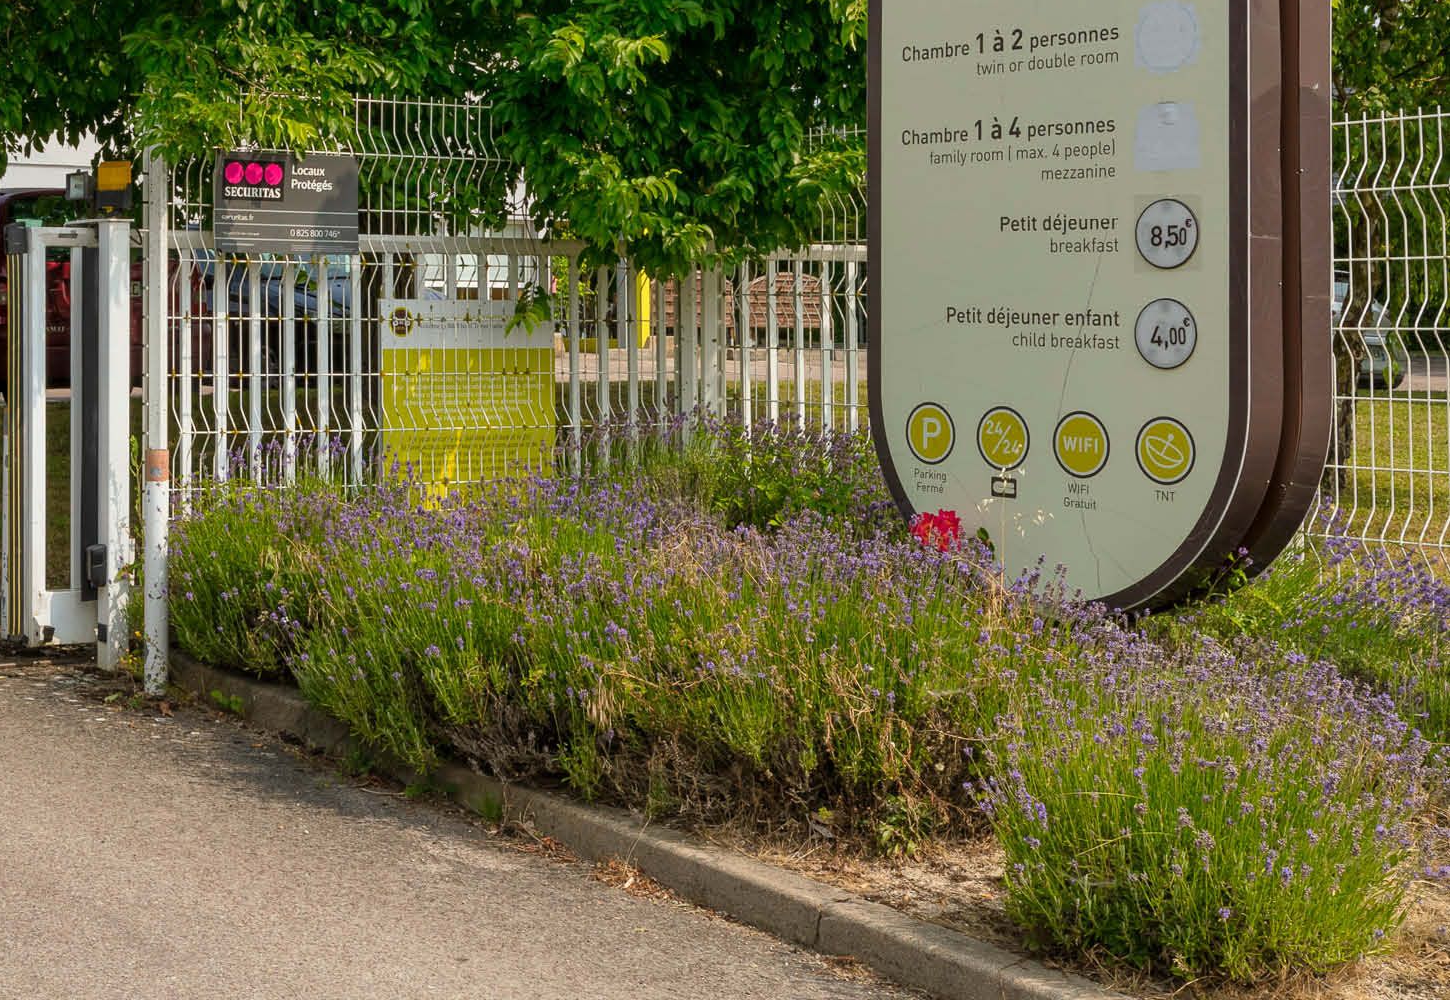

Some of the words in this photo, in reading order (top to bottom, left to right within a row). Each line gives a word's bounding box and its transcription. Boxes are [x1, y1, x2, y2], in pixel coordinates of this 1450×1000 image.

[902, 43, 970, 62] Chambre
[976, 33, 984, 54] 1
[993, 29, 1004, 52] à
[1011, 28, 1023, 50] 2
[1030, 27, 1119, 52] personnes
[976, 62, 1004, 75] twin
[1009, 61, 1024, 73] or
[1028, 53, 1075, 71] double
[1081, 51, 1119, 65] room
[902, 127, 968, 145] Chambre
[974, 120, 982, 140] 1
[991, 117, 1002, 140] à
[1008, 117, 1021, 138] 4
[1028, 120, 1115, 141] personnes
[930, 152, 967, 166] family
[971, 151, 1003, 163] room
[1052, 144, 1060, 158] 4
[291, 164, 325, 176] Locaux
[1041, 164, 1115, 181] mezzanine
[224, 186, 281, 198] SECURITAS
[291, 179, 333, 192] Protégés
[290, 228, 295, 236] 0
[296, 229, 309, 237] 825
[310, 229, 324, 237] 800
[1000, 216, 1037, 231] Petit
[1043, 214, 1119, 235] déjeuner
[1050, 237, 1119, 253] breakfast
[946, 307, 982, 324] Petit
[987, 307, 1060, 328] déjeuner
[1065, 309, 1120, 327] enfant
[1012, 332, 1045, 347] child
[1051, 332, 1120, 349] breakfast
[921, 417, 942, 449] P
[1063, 436, 1099, 454] WIFI
[914, 467, 947, 482] Parking
[916, 482, 944, 494] Fermé
[1154, 491, 1175, 502] TNT
[1063, 497, 1097, 510] Gratuit
